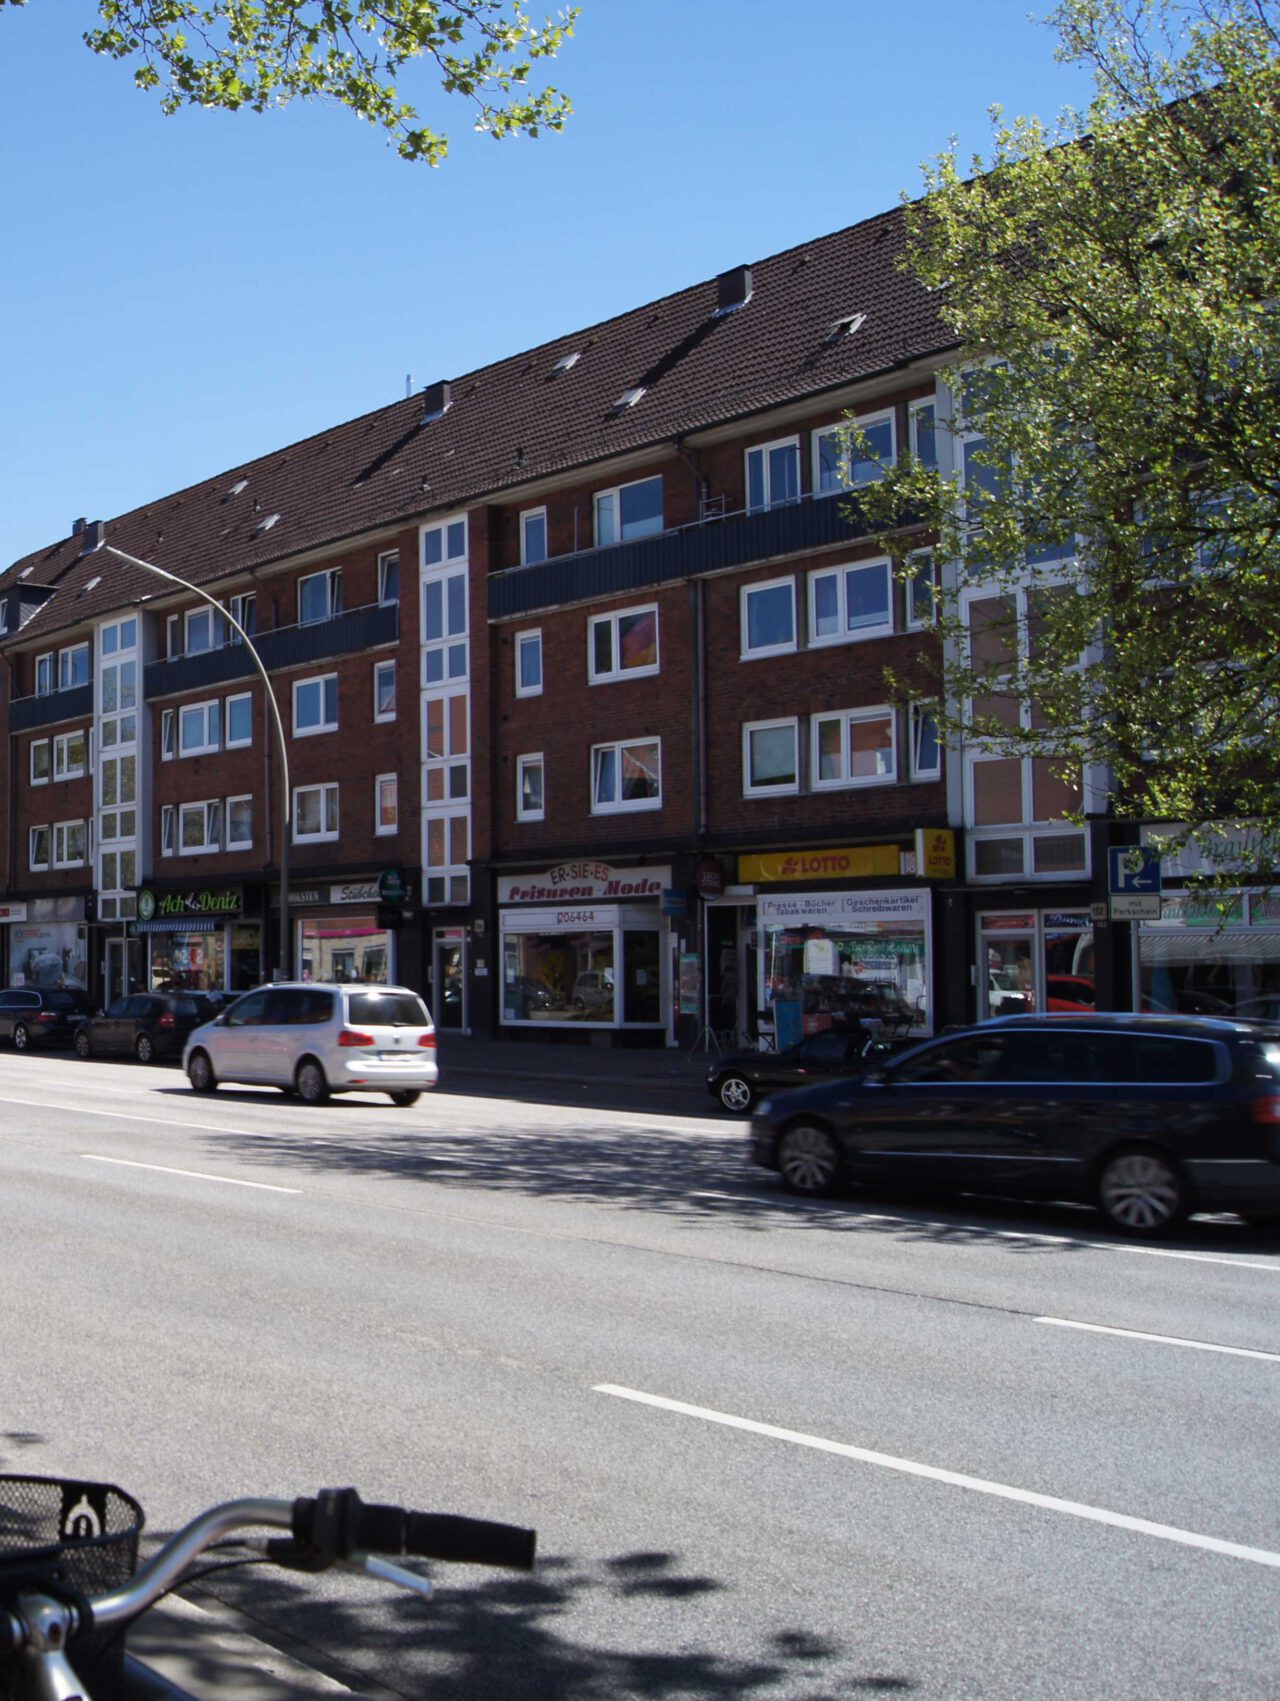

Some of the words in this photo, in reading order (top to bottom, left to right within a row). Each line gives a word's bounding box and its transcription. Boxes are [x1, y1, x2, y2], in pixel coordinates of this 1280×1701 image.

[802, 856, 850, 873] LOTTO
[928, 856, 951, 866] LOTTO
[603, 879, 661, 896] Mode
[768, 901, 797, 909] Presse
[847, 896, 919, 906] Geschenkartikel
[776, 907, 827, 915] Tabakwaren
[852, 904, 912, 913] Schreibwaren
[1114, 907, 1158, 916] Parkschein
